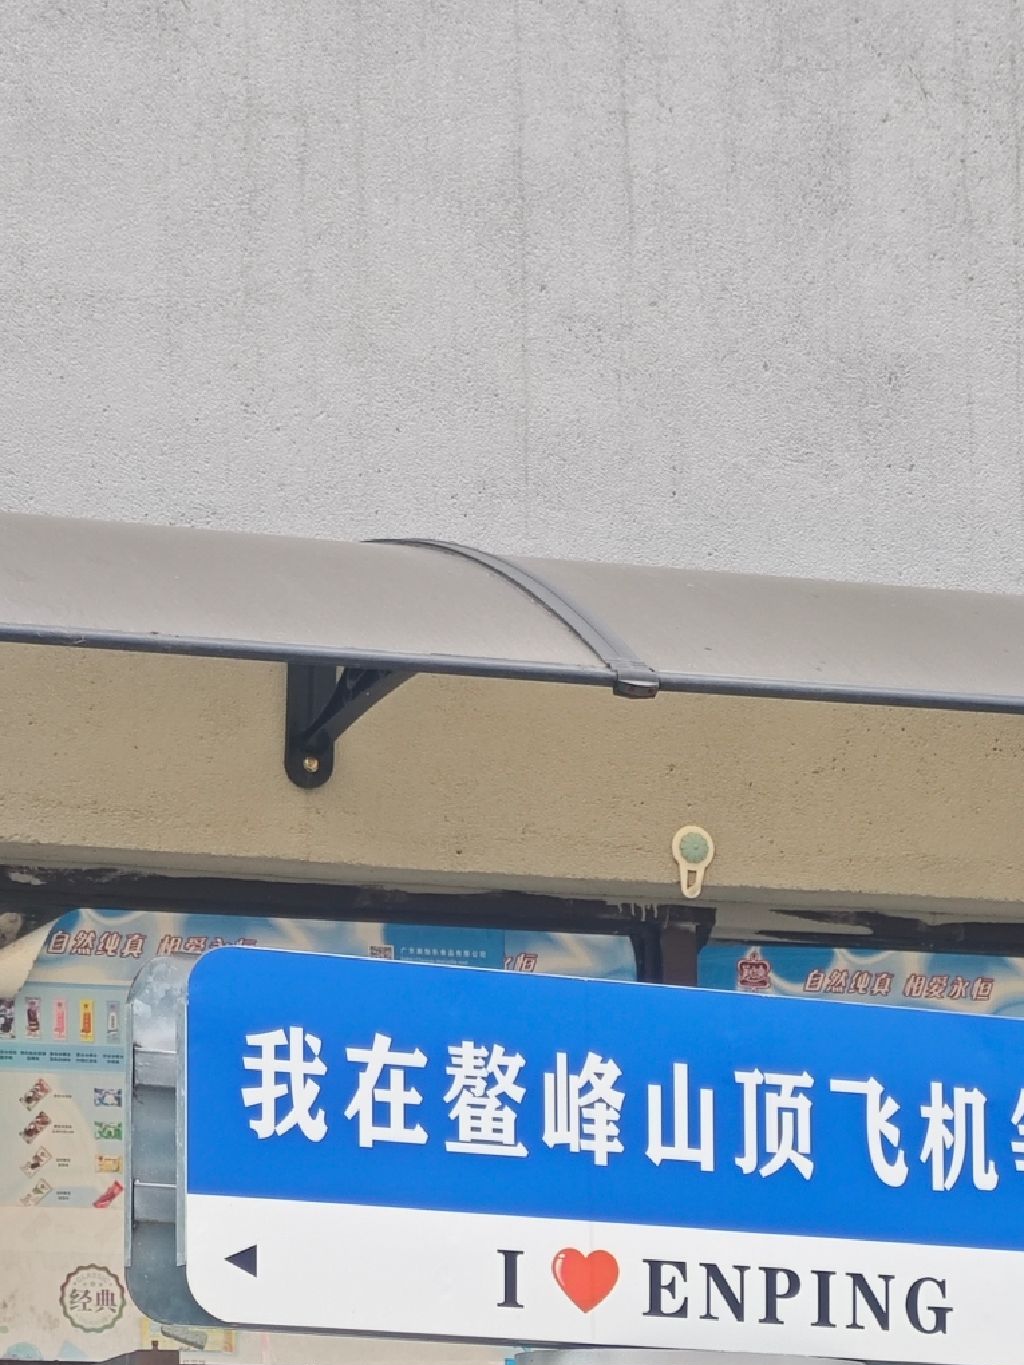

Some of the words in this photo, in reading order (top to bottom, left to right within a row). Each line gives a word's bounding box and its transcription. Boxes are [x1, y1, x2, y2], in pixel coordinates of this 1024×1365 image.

[46, 929, 147, 958] 自然纯真
[157, 933, 258, 955] 相爱
[803, 968, 895, 995] 自然纯真
[903, 973, 995, 1001] 相爱永恒
[69, 1289, 118, 1314] 经典
[497, 1249, 524, 1308] I
[643, 1258, 953, 1335] ENPING
